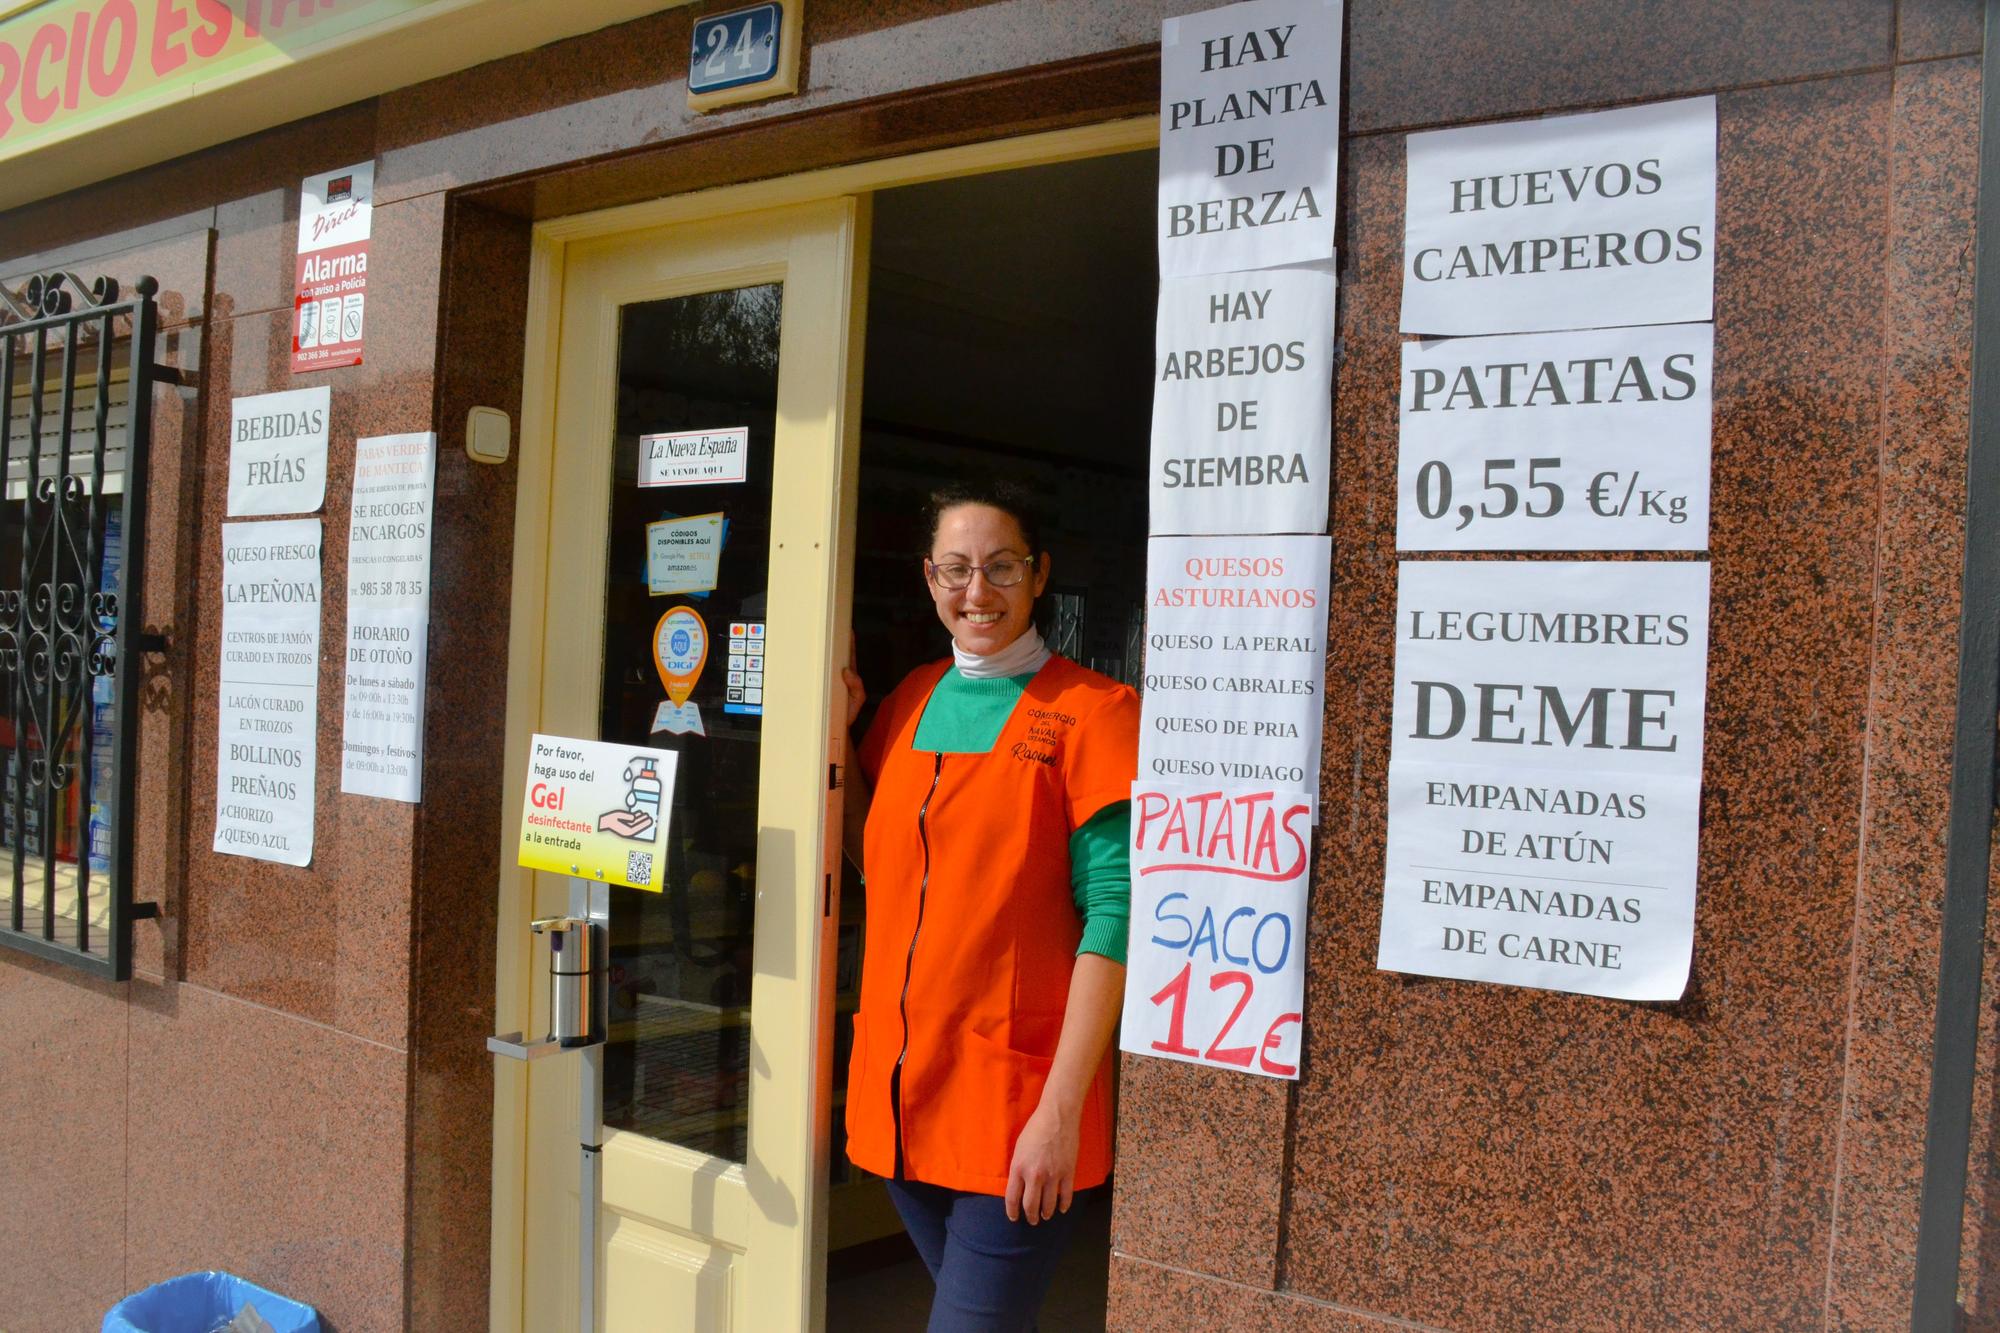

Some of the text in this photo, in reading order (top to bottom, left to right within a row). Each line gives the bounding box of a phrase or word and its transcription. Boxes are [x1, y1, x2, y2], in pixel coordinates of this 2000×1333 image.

[705, 18, 754, 77] 24
[1200, 24, 1297, 73] HAY
[1169, 79, 1328, 131] PLANTA
[1214, 138, 1274, 178] DE
[1449, 158, 1662, 214] HUEVOS
[312, 196, 366, 241] Direct
[1166, 186, 1322, 238] BERZA
[1413, 225, 1702, 282] CAMPEROS
[302, 252, 367, 284] Alarma
[301, 287, 313, 298] con
[314, 283, 334, 297] aviso
[335, 284, 339, 292] a
[1209, 289, 1273, 324] HAY
[308, 351, 318, 360] 366
[319, 350, 329, 359] 366
[1162, 341, 1305, 381] ARBEJOS
[1409, 353, 1696, 412] PATATAS
[236, 409, 322, 442] BEBIDAS
[1217, 400, 1259, 432] DE
[386, 443, 429, 457] VERDES
[649, 436, 738, 459] La Nueva España
[247, 453, 306, 486] FRÍAS
[375, 462, 423, 476] MANTECA
[660, 469, 669, 477] SE
[671, 467, 698, 476] VENDE
[1163, 453, 1309, 488] SIEMBRA
[1416, 457, 1687, 532] 0,55 €/Kg
[354, 501, 425, 518] SE RECOGEN
[352, 523, 425, 541] ENCARGOS
[670, 528, 698, 537] CÓDIGOS
[695, 536, 711, 545] AQUÍ
[227, 544, 316, 565] QUESO FRESCO
[352, 556, 376, 564] FRESCAS
[382, 554, 423, 563] CONGELADAS
[1185, 557, 1284, 581] QUESOS
[227, 578, 317, 603] LA PEÑONA
[360, 582, 377, 595] 985
[380, 581, 392, 595] 58
[395, 581, 406, 595] 78
[408, 581, 422, 595] 35
[1153, 588, 1316, 609] ASTURIANOS
[227, 630, 313, 645] CENTROS DE JAMÓN
[352, 625, 410, 642] HORARIO
[1409, 610, 1689, 646] LEGUMBRES
[1150, 634, 1317, 653] QUESO LA PERAL
[226, 651, 312, 665] CURADO EN TROZOS
[350, 646, 412, 665] DE OTOÑO
[347, 674, 357, 686] De
[359, 675, 379, 687] lunes
[388, 677, 415, 690] sábado
[1145, 674, 1315, 695] QUESO CABRALES
[228, 694, 304, 713] LACÓN CURADO
[352, 708, 360, 719] de
[239, 718, 293, 734] EN TROZOS
[1027, 709, 1076, 726] COMERCIO
[1155, 717, 1299, 738] QUESO DE PRIA
[1408, 680, 1677, 753] DEME
[230, 743, 302, 768] BOLLINOS
[343, 740, 380, 756] Domingos
[386, 744, 417, 759] festivos
[536, 743, 585, 763] Por favor,
[346, 759, 355, 769] de
[534, 763, 595, 782] haga uso del
[1152, 758, 1304, 782] QUESO VIDIAGO
[231, 774, 297, 800] PREÑAOS
[531, 783, 565, 811] Gel
[1425, 781, 1646, 820] EMPANADAS
[226, 804, 274, 824] CHORIZO
[528, 813, 592, 834] desinfectante
[225, 828, 290, 851] QUESO AZUL
[533, 832, 542, 844] la
[545, 837, 582, 850] entrada
[1135, 791, 1310, 880] PATATAS
[1461, 829, 1614, 865] DE ATÚN
[1421, 879, 1641, 924] EMPANADAS
[1151, 892, 1291, 974] SACO
[1441, 926, 1622, 970] DE CARNE
[1150, 961, 1302, 1076] 12€
